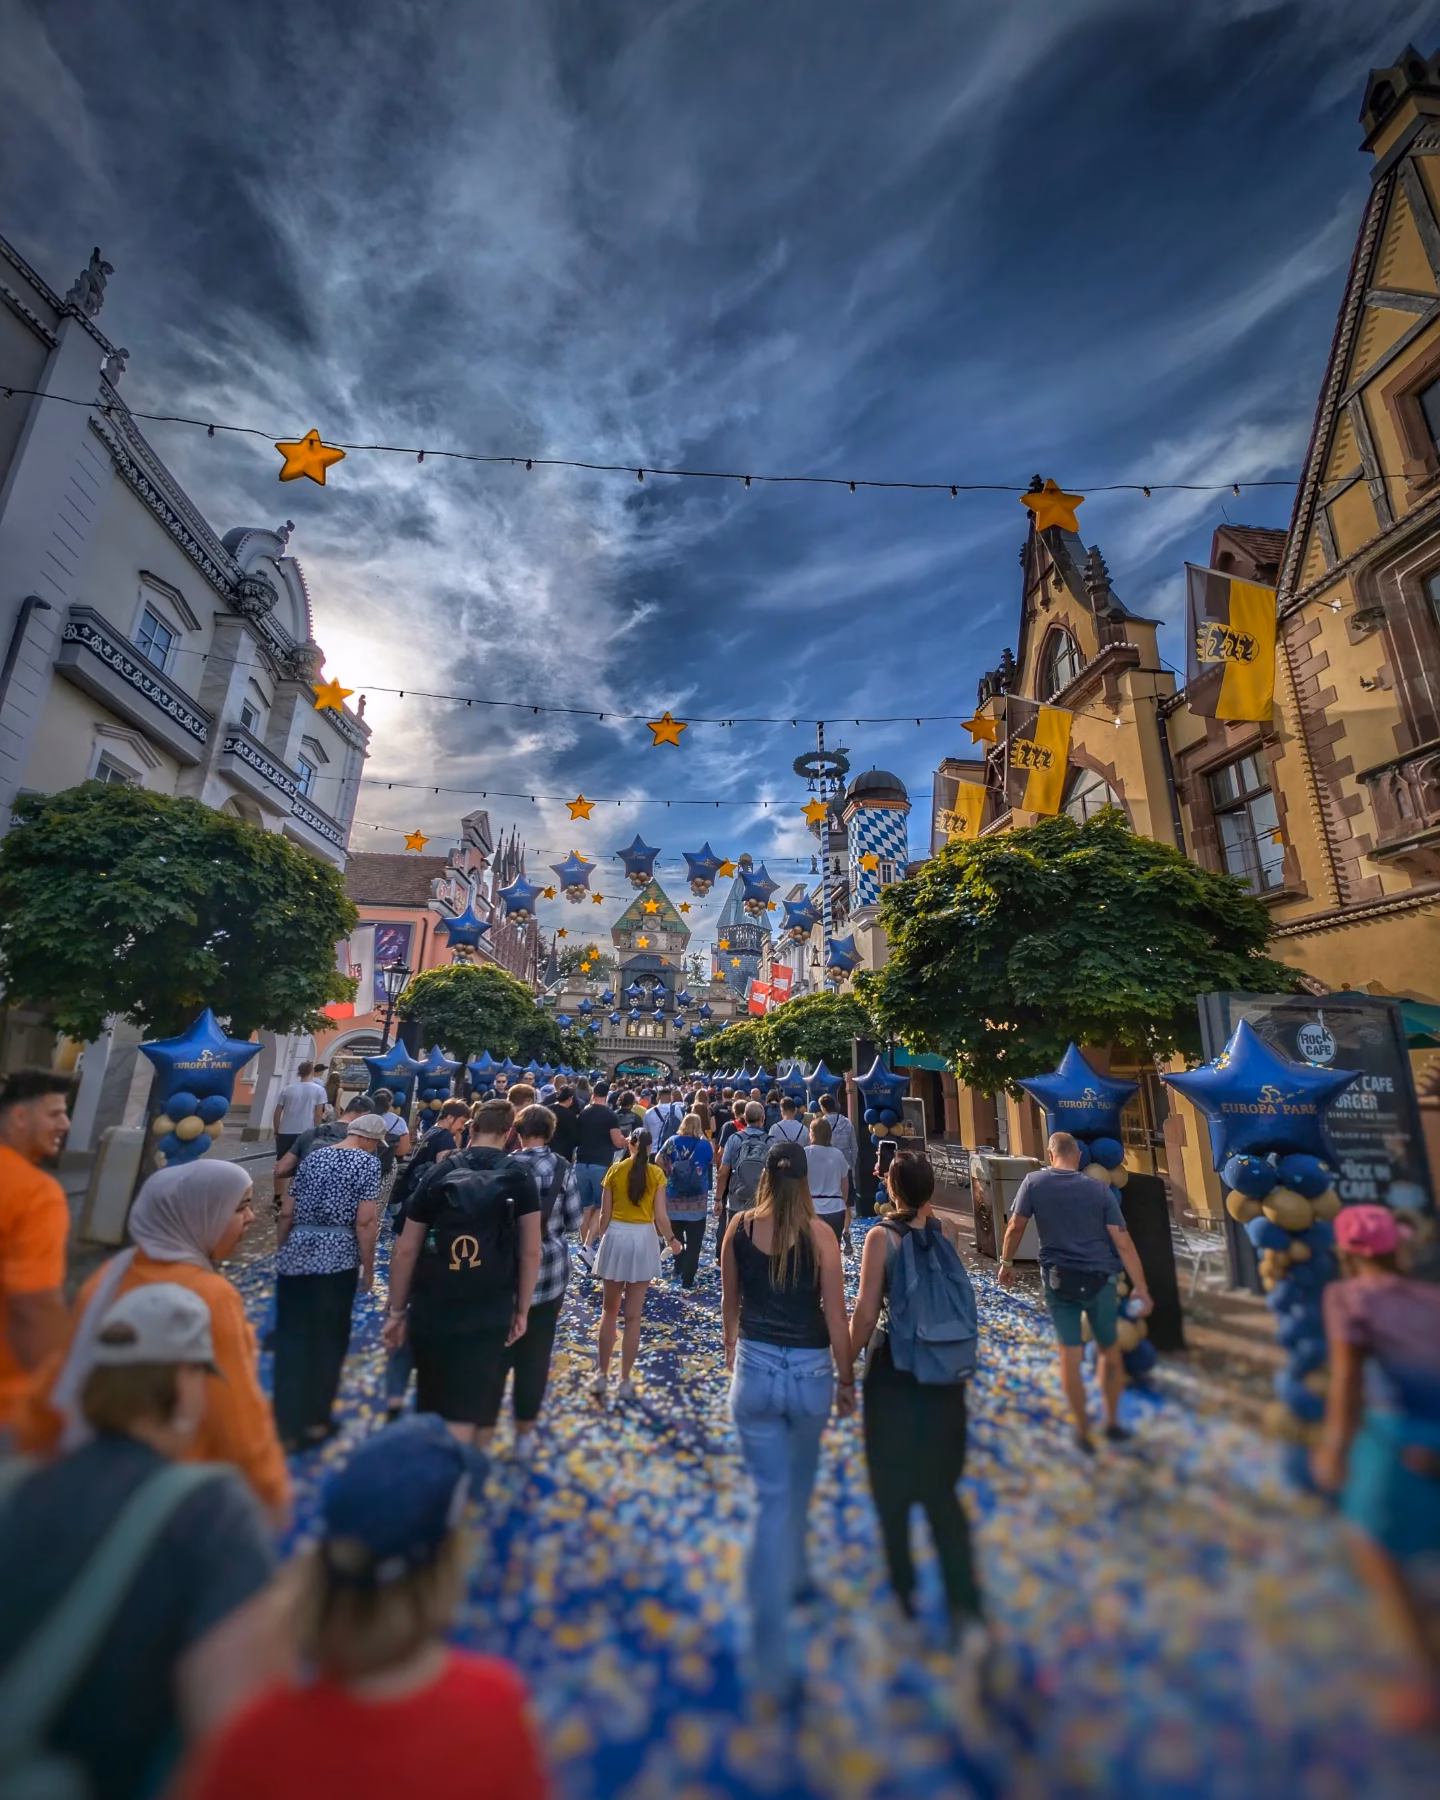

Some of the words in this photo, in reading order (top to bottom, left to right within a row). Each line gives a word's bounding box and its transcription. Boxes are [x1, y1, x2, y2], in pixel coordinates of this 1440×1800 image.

[1300, 1028, 1332, 1045] ROCK
[1306, 1045, 1332, 1056] CAFE
[1362, 1076, 1394, 1093] CAFE
[1058, 1101, 1094, 1109] EUROPA
[1335, 1094, 1378, 1110] URGER
[1221, 1103, 1277, 1114] EUROPA
[1283, 1104, 1317, 1115] PARK
[1327, 1112, 1358, 1120] SIMPLY
